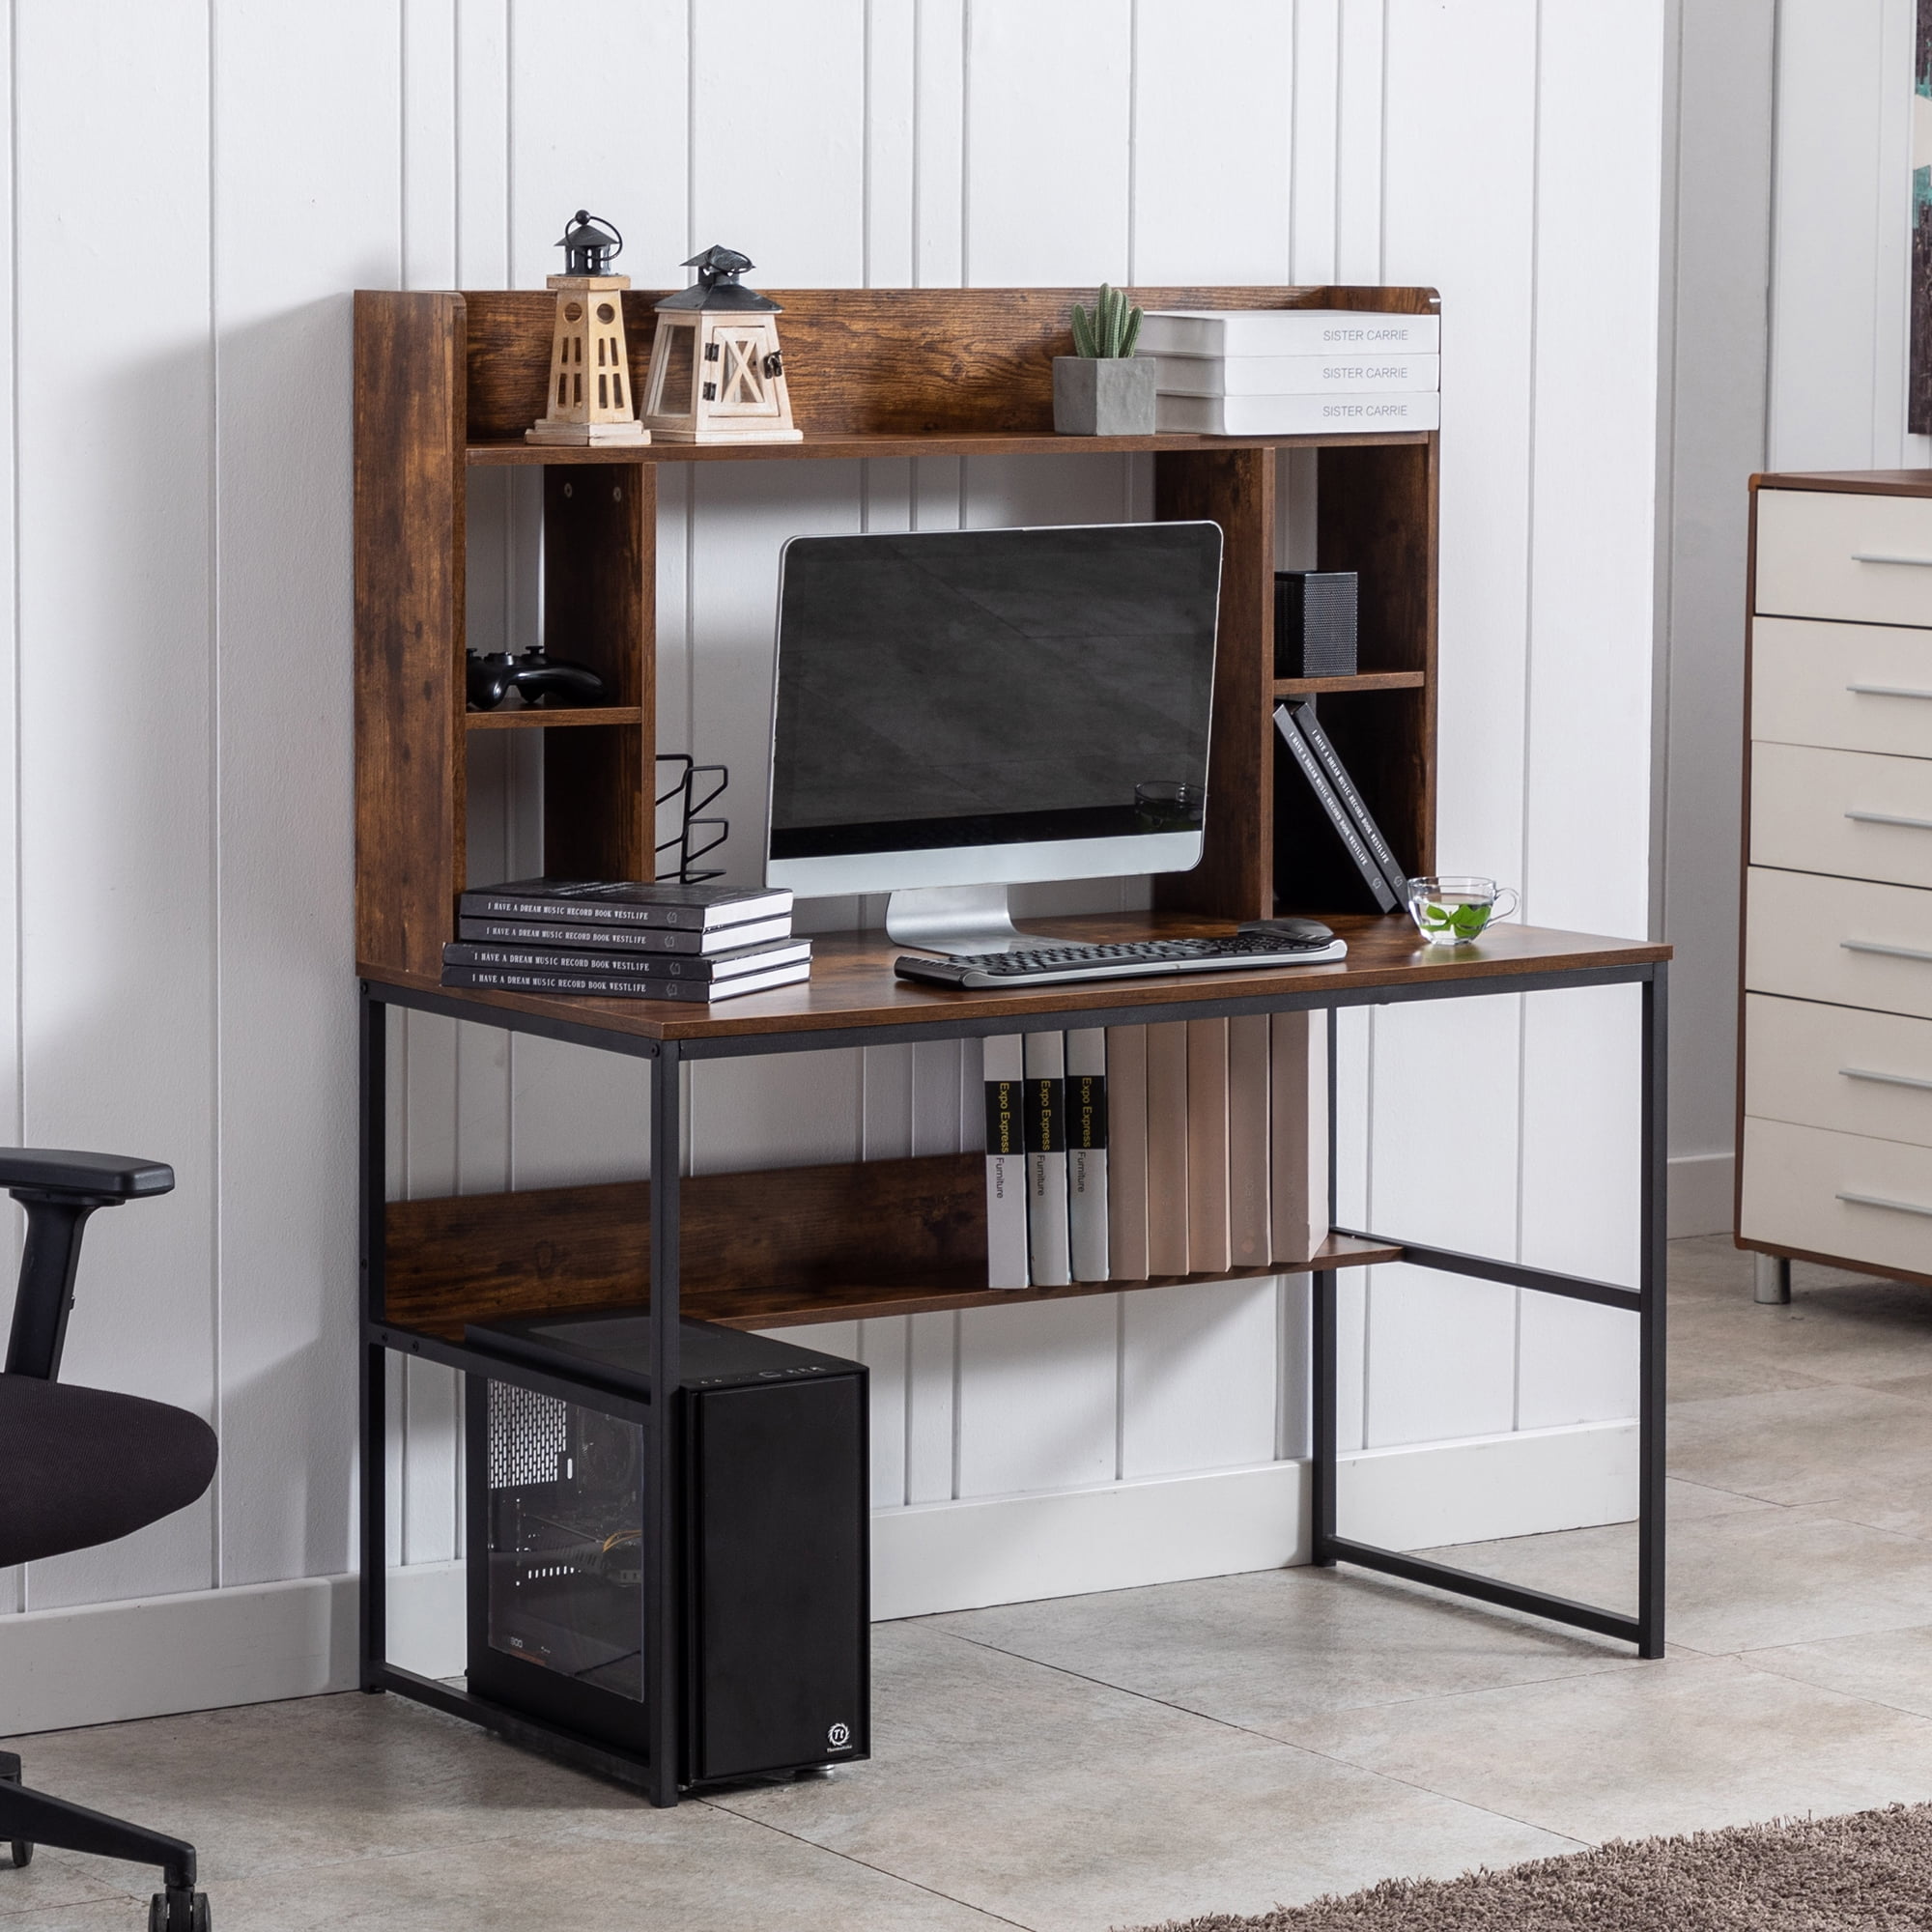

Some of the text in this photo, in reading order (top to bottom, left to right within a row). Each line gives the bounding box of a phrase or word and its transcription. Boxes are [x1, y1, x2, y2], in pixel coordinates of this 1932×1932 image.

[1323, 329, 1408, 341] SISTER CARRIE
[1323, 367, 1407, 379] SISTER CARRIE
[1323, 405, 1407, 417] SISTER CARRIE
[494, 903, 511, 911] HAVE
[520, 905, 541, 913] DREAM
[543, 906, 564, 914] MUSIC
[567, 908, 592, 916] RECORD
[542, 931, 562, 939] MUSIC
[565, 932, 591, 940] RECORD
[593, 933, 610, 941] BOOK
[481, 952, 499, 962] HAVE
[510, 954, 533, 964] DREAM
[535, 956, 558, 965] MUSIC
[561, 958, 589, 967] RECORD
[591, 960, 610, 968] BOOK
[479, 974, 497, 983] HAVE
[508, 976, 530, 985] DREAM
[533, 978, 556, 987] MUSIC
[558, 979, 586, 989] RECORD
[588, 980, 607, 990] BOOK
[998, 1082, 1010, 1153] Expo Express
[1039, 1080, 1051, 1151] Expo Express
[1080, 1078, 1092, 1148] Expo Express
[995, 1157, 1004, 1199] Furniture
[1037, 1155, 1045, 1196] Furniture
[1078, 1151, 1086, 1193] Furniture
